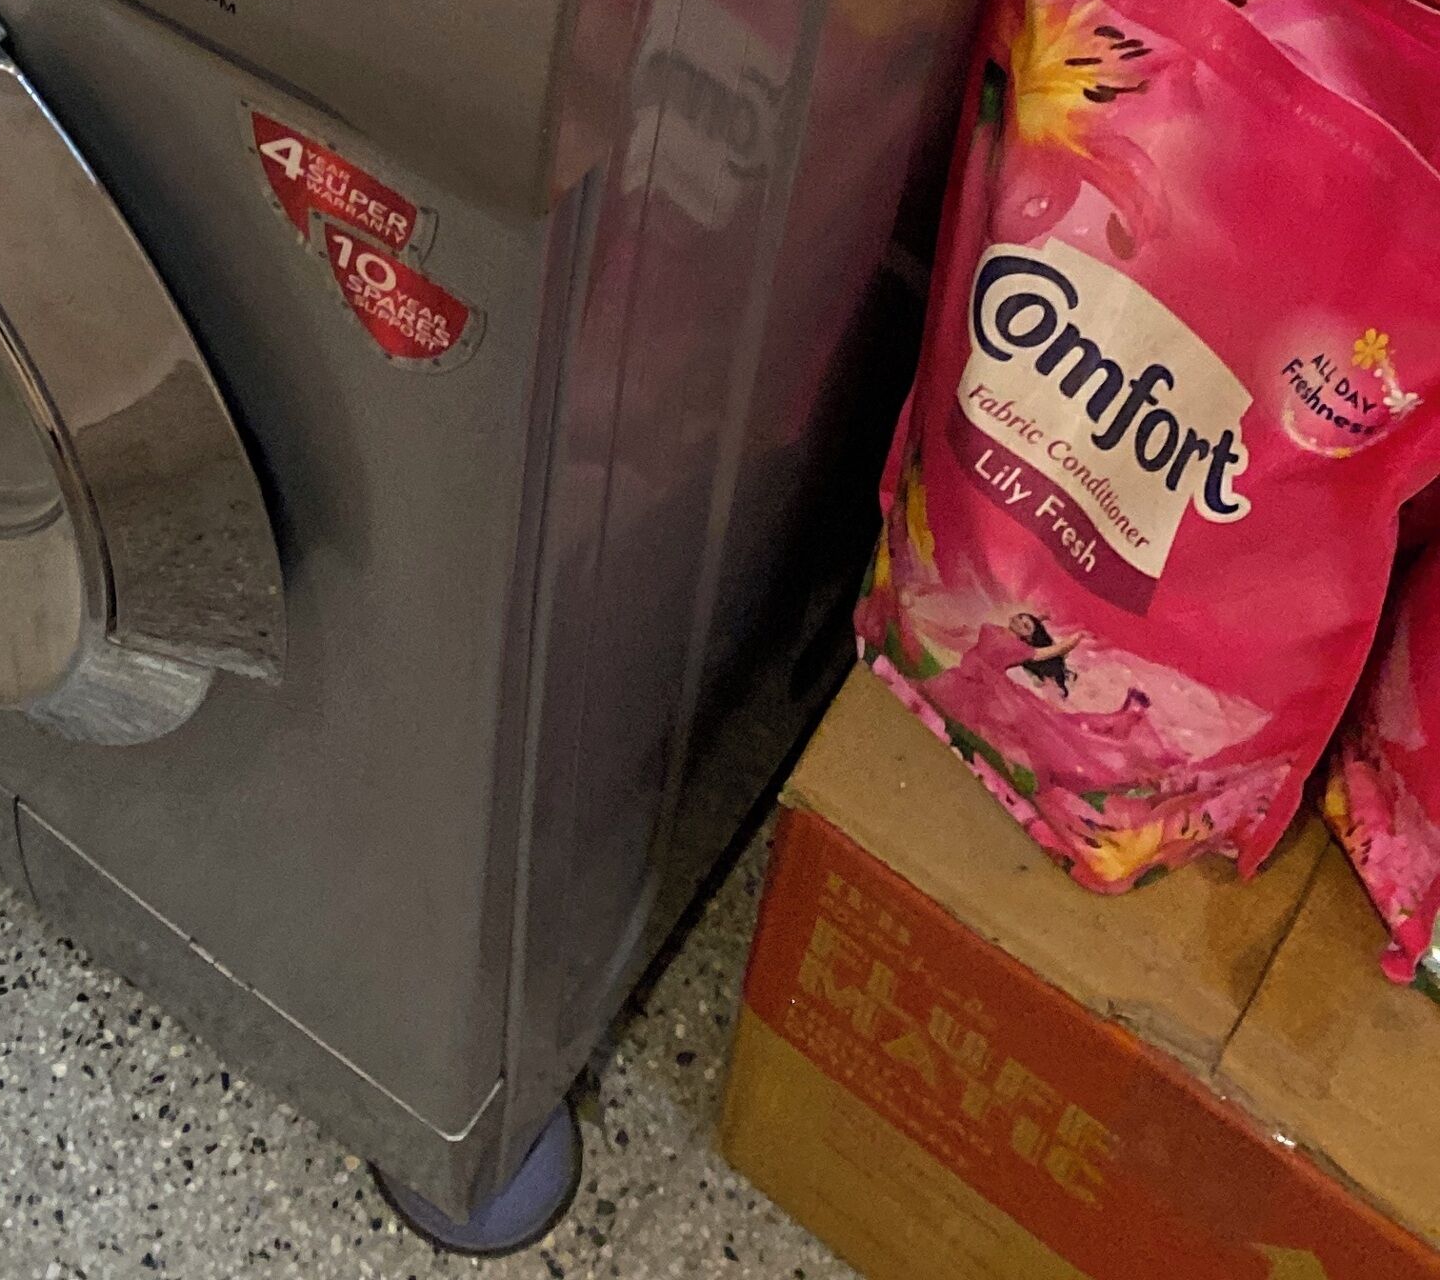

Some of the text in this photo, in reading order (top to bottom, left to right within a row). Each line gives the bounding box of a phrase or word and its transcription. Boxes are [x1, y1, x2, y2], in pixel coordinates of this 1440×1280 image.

[259, 136, 306, 182] 4
[307, 162, 409, 235] SUPER
[332, 234, 398, 293] 10
[972, 254, 1241, 516] Comfort
[1310, 352, 1378, 416] ALL DAY
[967, 383, 1152, 552] Fabric Conditioner
[973, 448, 1098, 574] Lily Fresh
